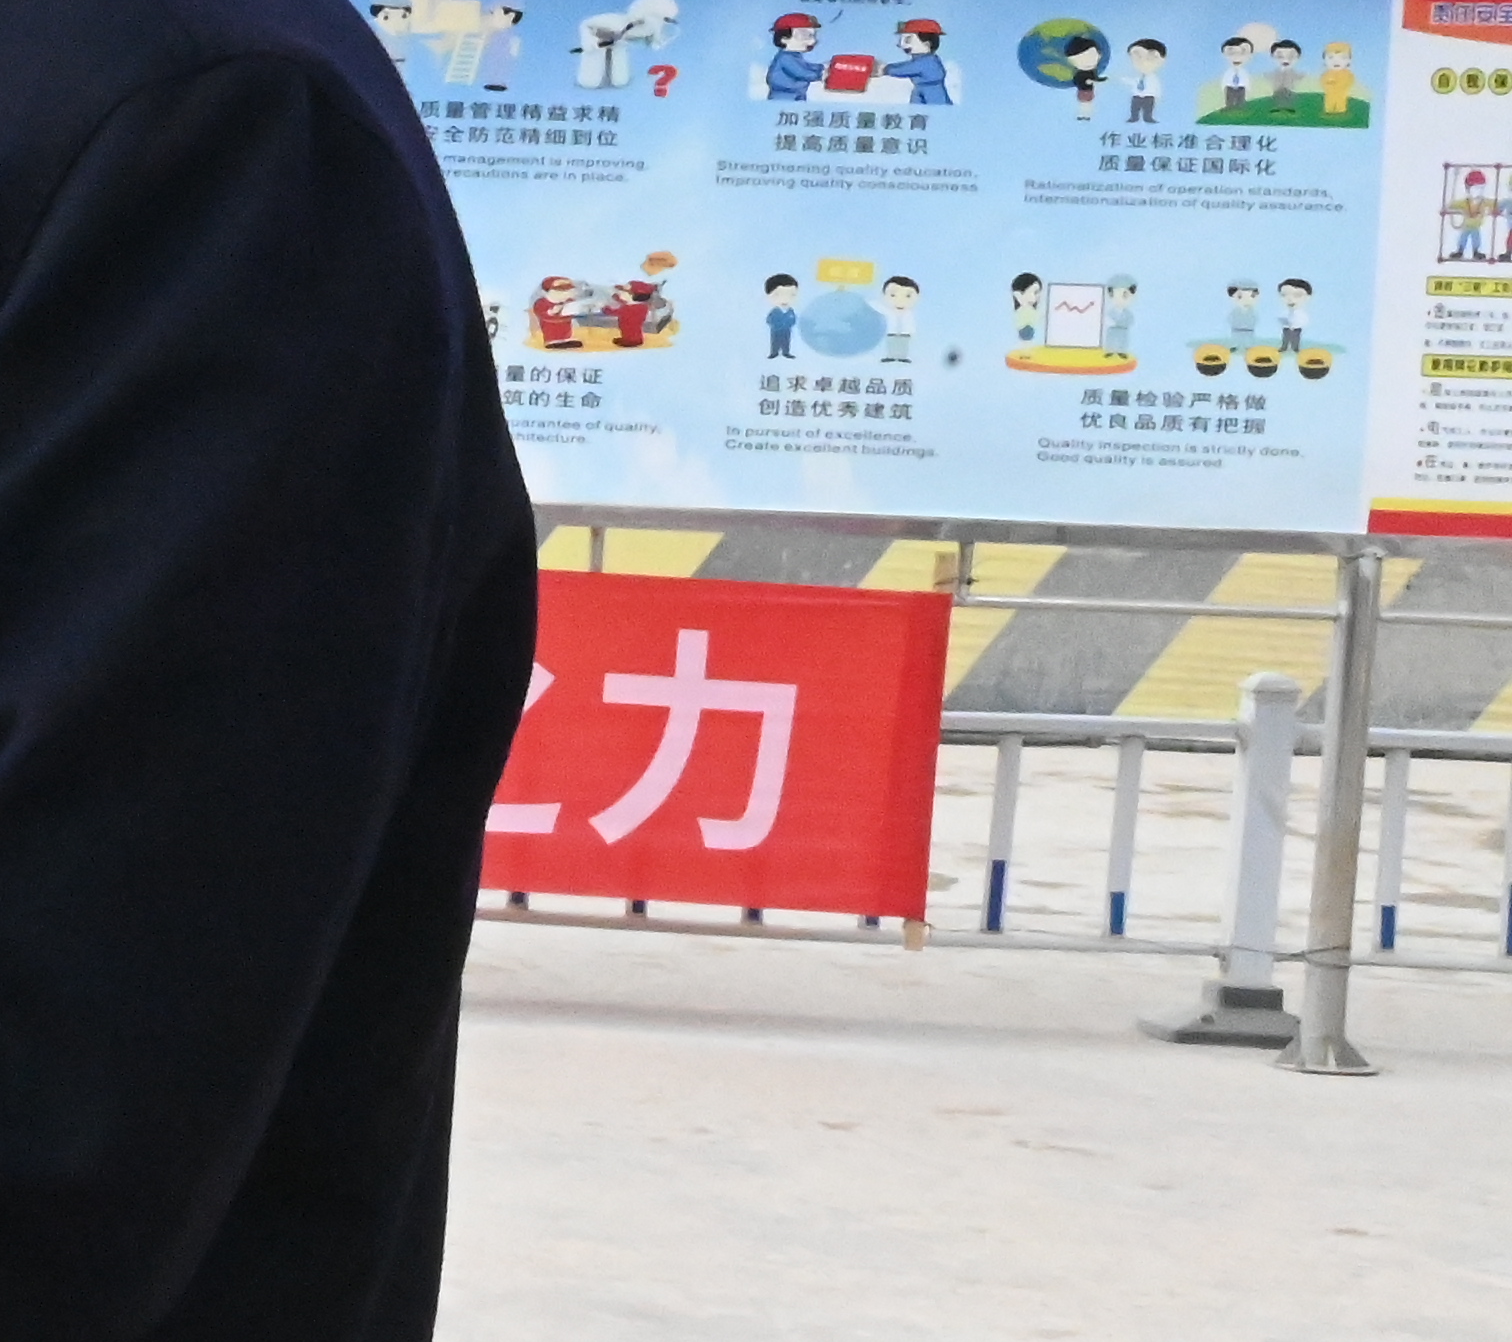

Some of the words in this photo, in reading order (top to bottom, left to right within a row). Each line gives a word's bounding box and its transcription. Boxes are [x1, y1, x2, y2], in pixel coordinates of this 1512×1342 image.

[420, 100, 620, 123] 质量管理精益求精
[776, 110, 928, 131] 加强质量教育
[775, 133, 928, 155] 提高质量意识
[1100, 131, 1278, 153] 作业标准合理化
[443, 155, 545, 166] management
[1098, 155, 1276, 176] 质量保证国际化
[443, 168, 528, 180] recautions
[836, 164, 888, 178] quality
[716, 176, 795, 189] Improving
[801, 178, 853, 191] quality
[859, 180, 978, 192] consciousness
[1025, 179, 1144, 192] Rationalization
[1149, 183, 1164, 193] of
[1168, 184, 1243, 196] operation
[1024, 195, 1177, 208] Internationalization
[1183, 198, 1198, 208] of
[1201, 199, 1254, 211] quality
[506, 365, 603, 384] 量的保证
[760, 375, 913, 396] 追求卓越品质
[503, 390, 602, 408] 筑的生命
[1081, 389, 1266, 410] 质量检验严格做
[759, 398, 913, 420] 创造优秀建筑
[510, 420, 580, 430] uarantee
[586, 421, 600, 430] of
[1081, 412, 1266, 434] 优良品质有把握
[745, 427, 800, 438] pursuit
[805, 428, 821, 438] of
[725, 439, 779, 451] Create
[784, 442, 857, 454] excellent
[1038, 438, 1093, 451] Quality
[1098, 440, 1180, 454] inspection
[1037, 452, 1079, 462] Good
[1084, 454, 1136, 467] quality
